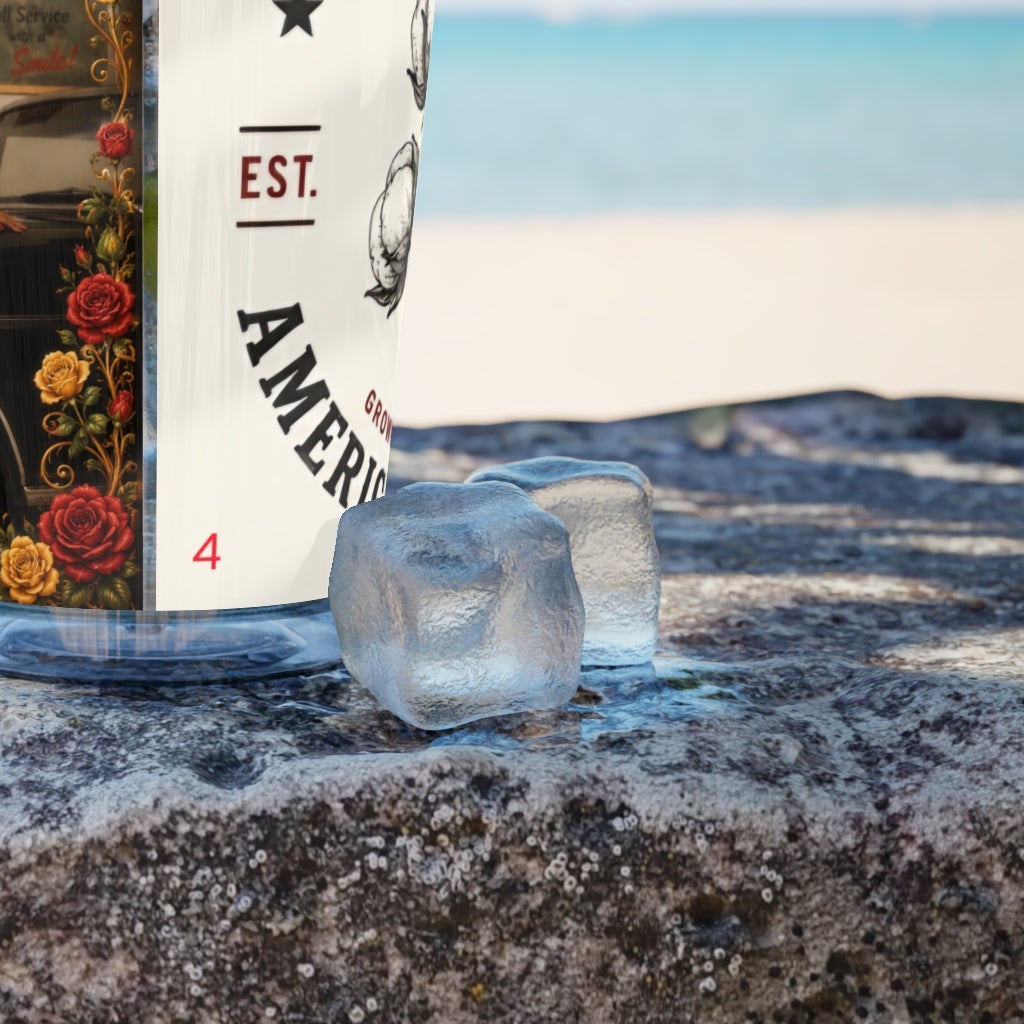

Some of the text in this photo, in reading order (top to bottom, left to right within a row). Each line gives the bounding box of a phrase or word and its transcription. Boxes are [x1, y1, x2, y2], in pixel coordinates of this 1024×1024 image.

[16, 6, 70, 24] Service
[9, 29, 33, 43] with
[240, 155, 317, 199] EST.
[192, 532, 221, 570] 4
